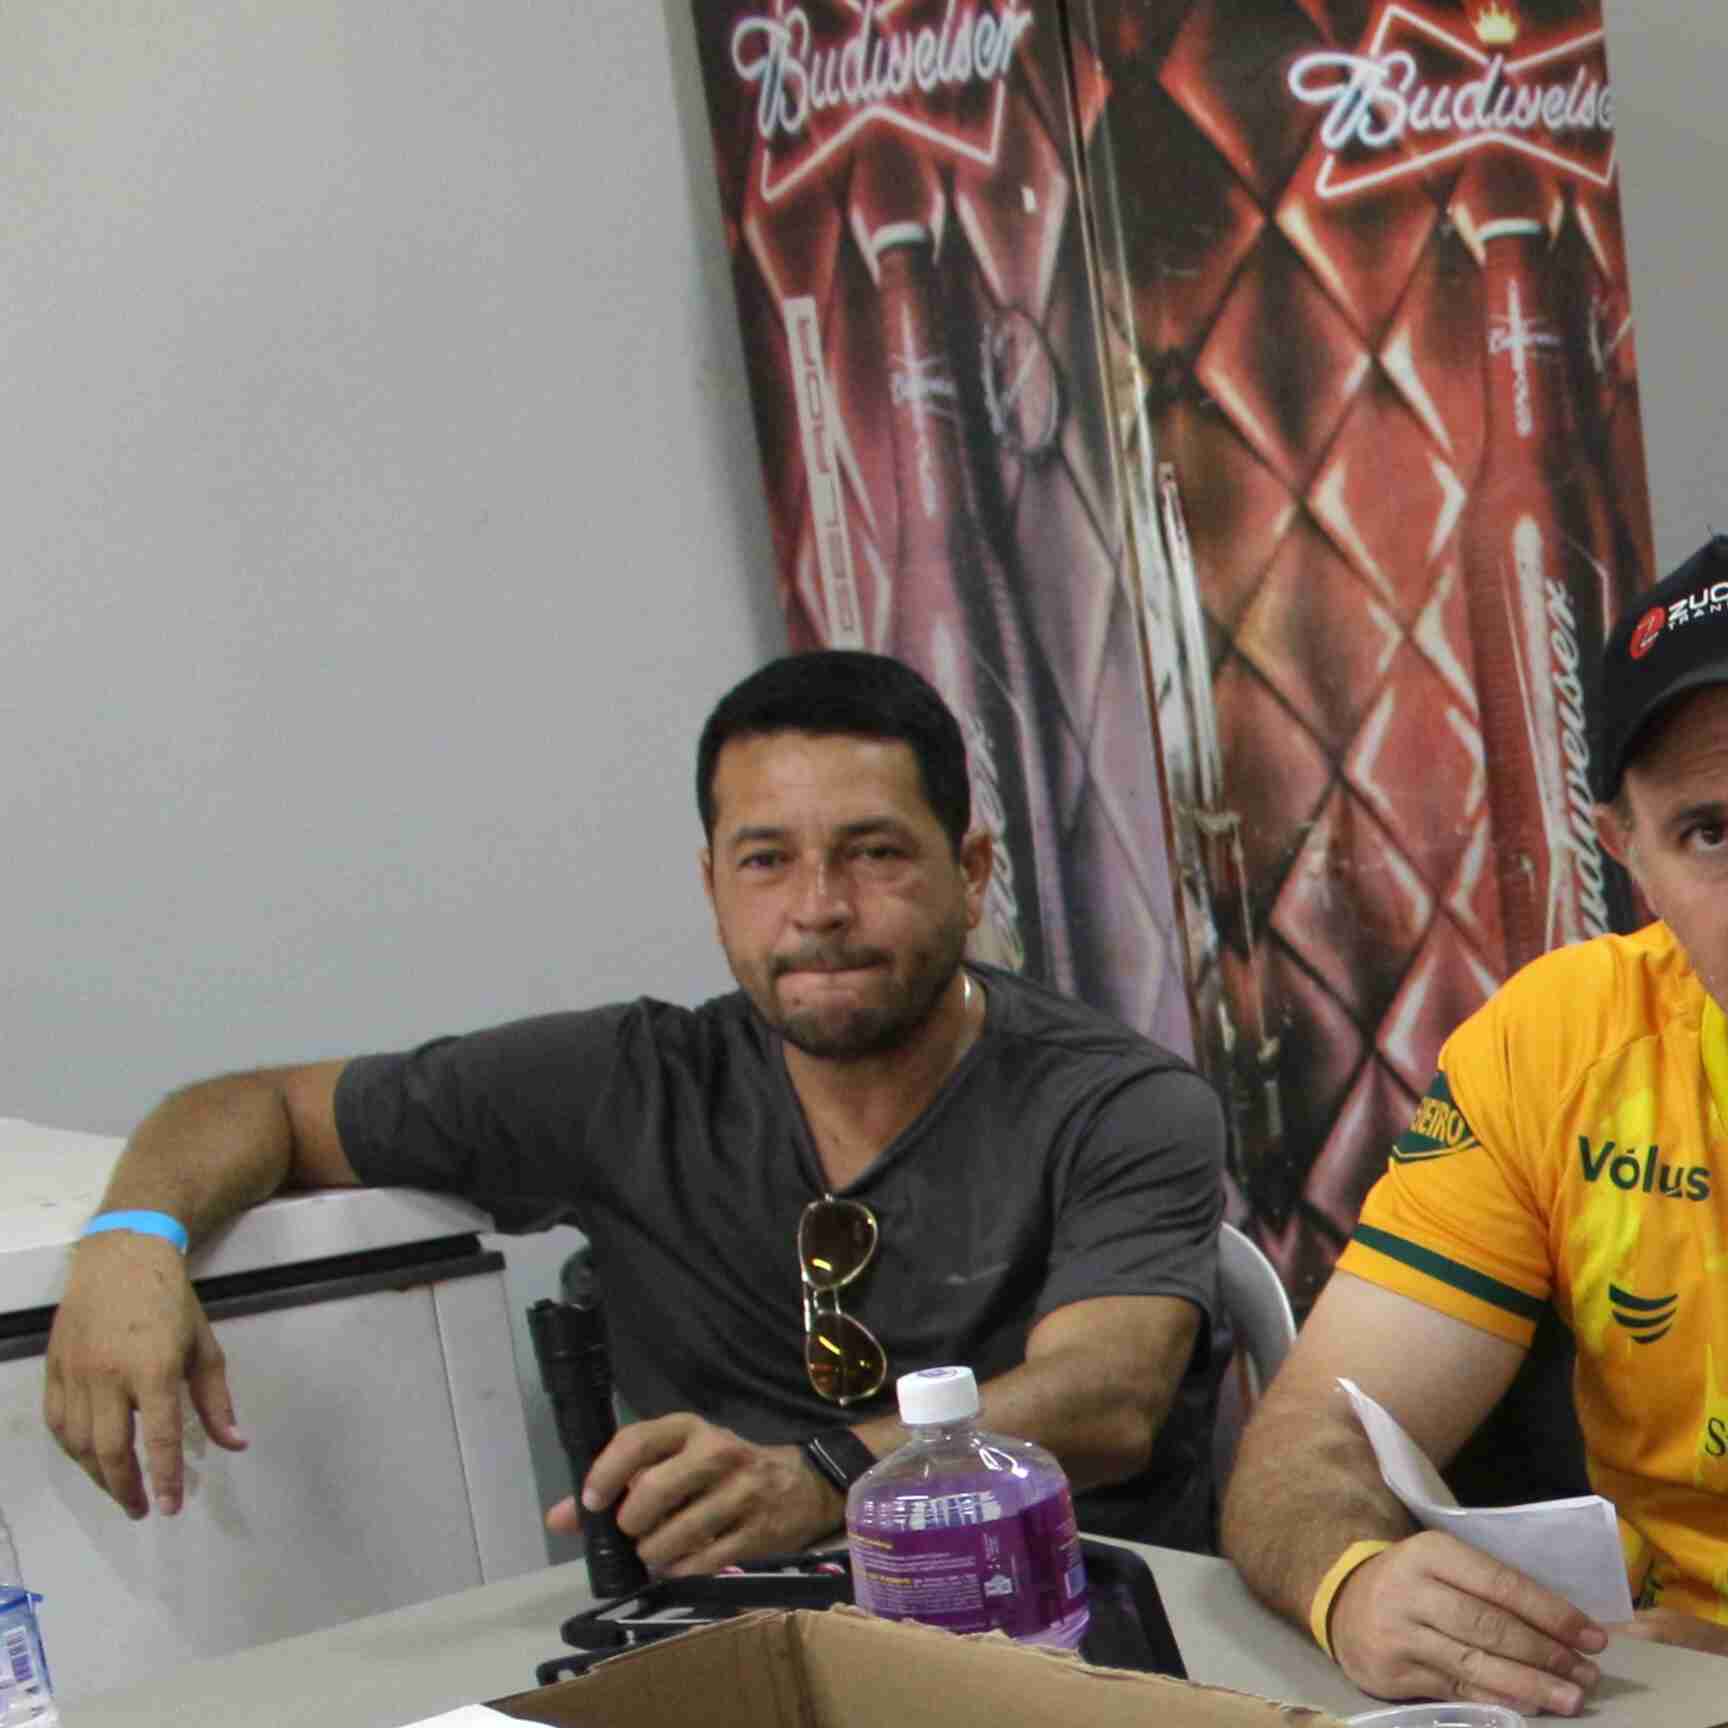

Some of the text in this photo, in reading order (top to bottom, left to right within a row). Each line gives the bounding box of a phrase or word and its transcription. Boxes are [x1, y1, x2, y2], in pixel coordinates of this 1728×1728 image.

[731, 0, 1033, 139] Budweiser
[1288, 51, 1616, 148] Budweise
[1545, 577, 1609, 938] udweiser
[1411, 1097, 1464, 1146] EIRO
[1578, 1136, 1711, 1201] Vólus
